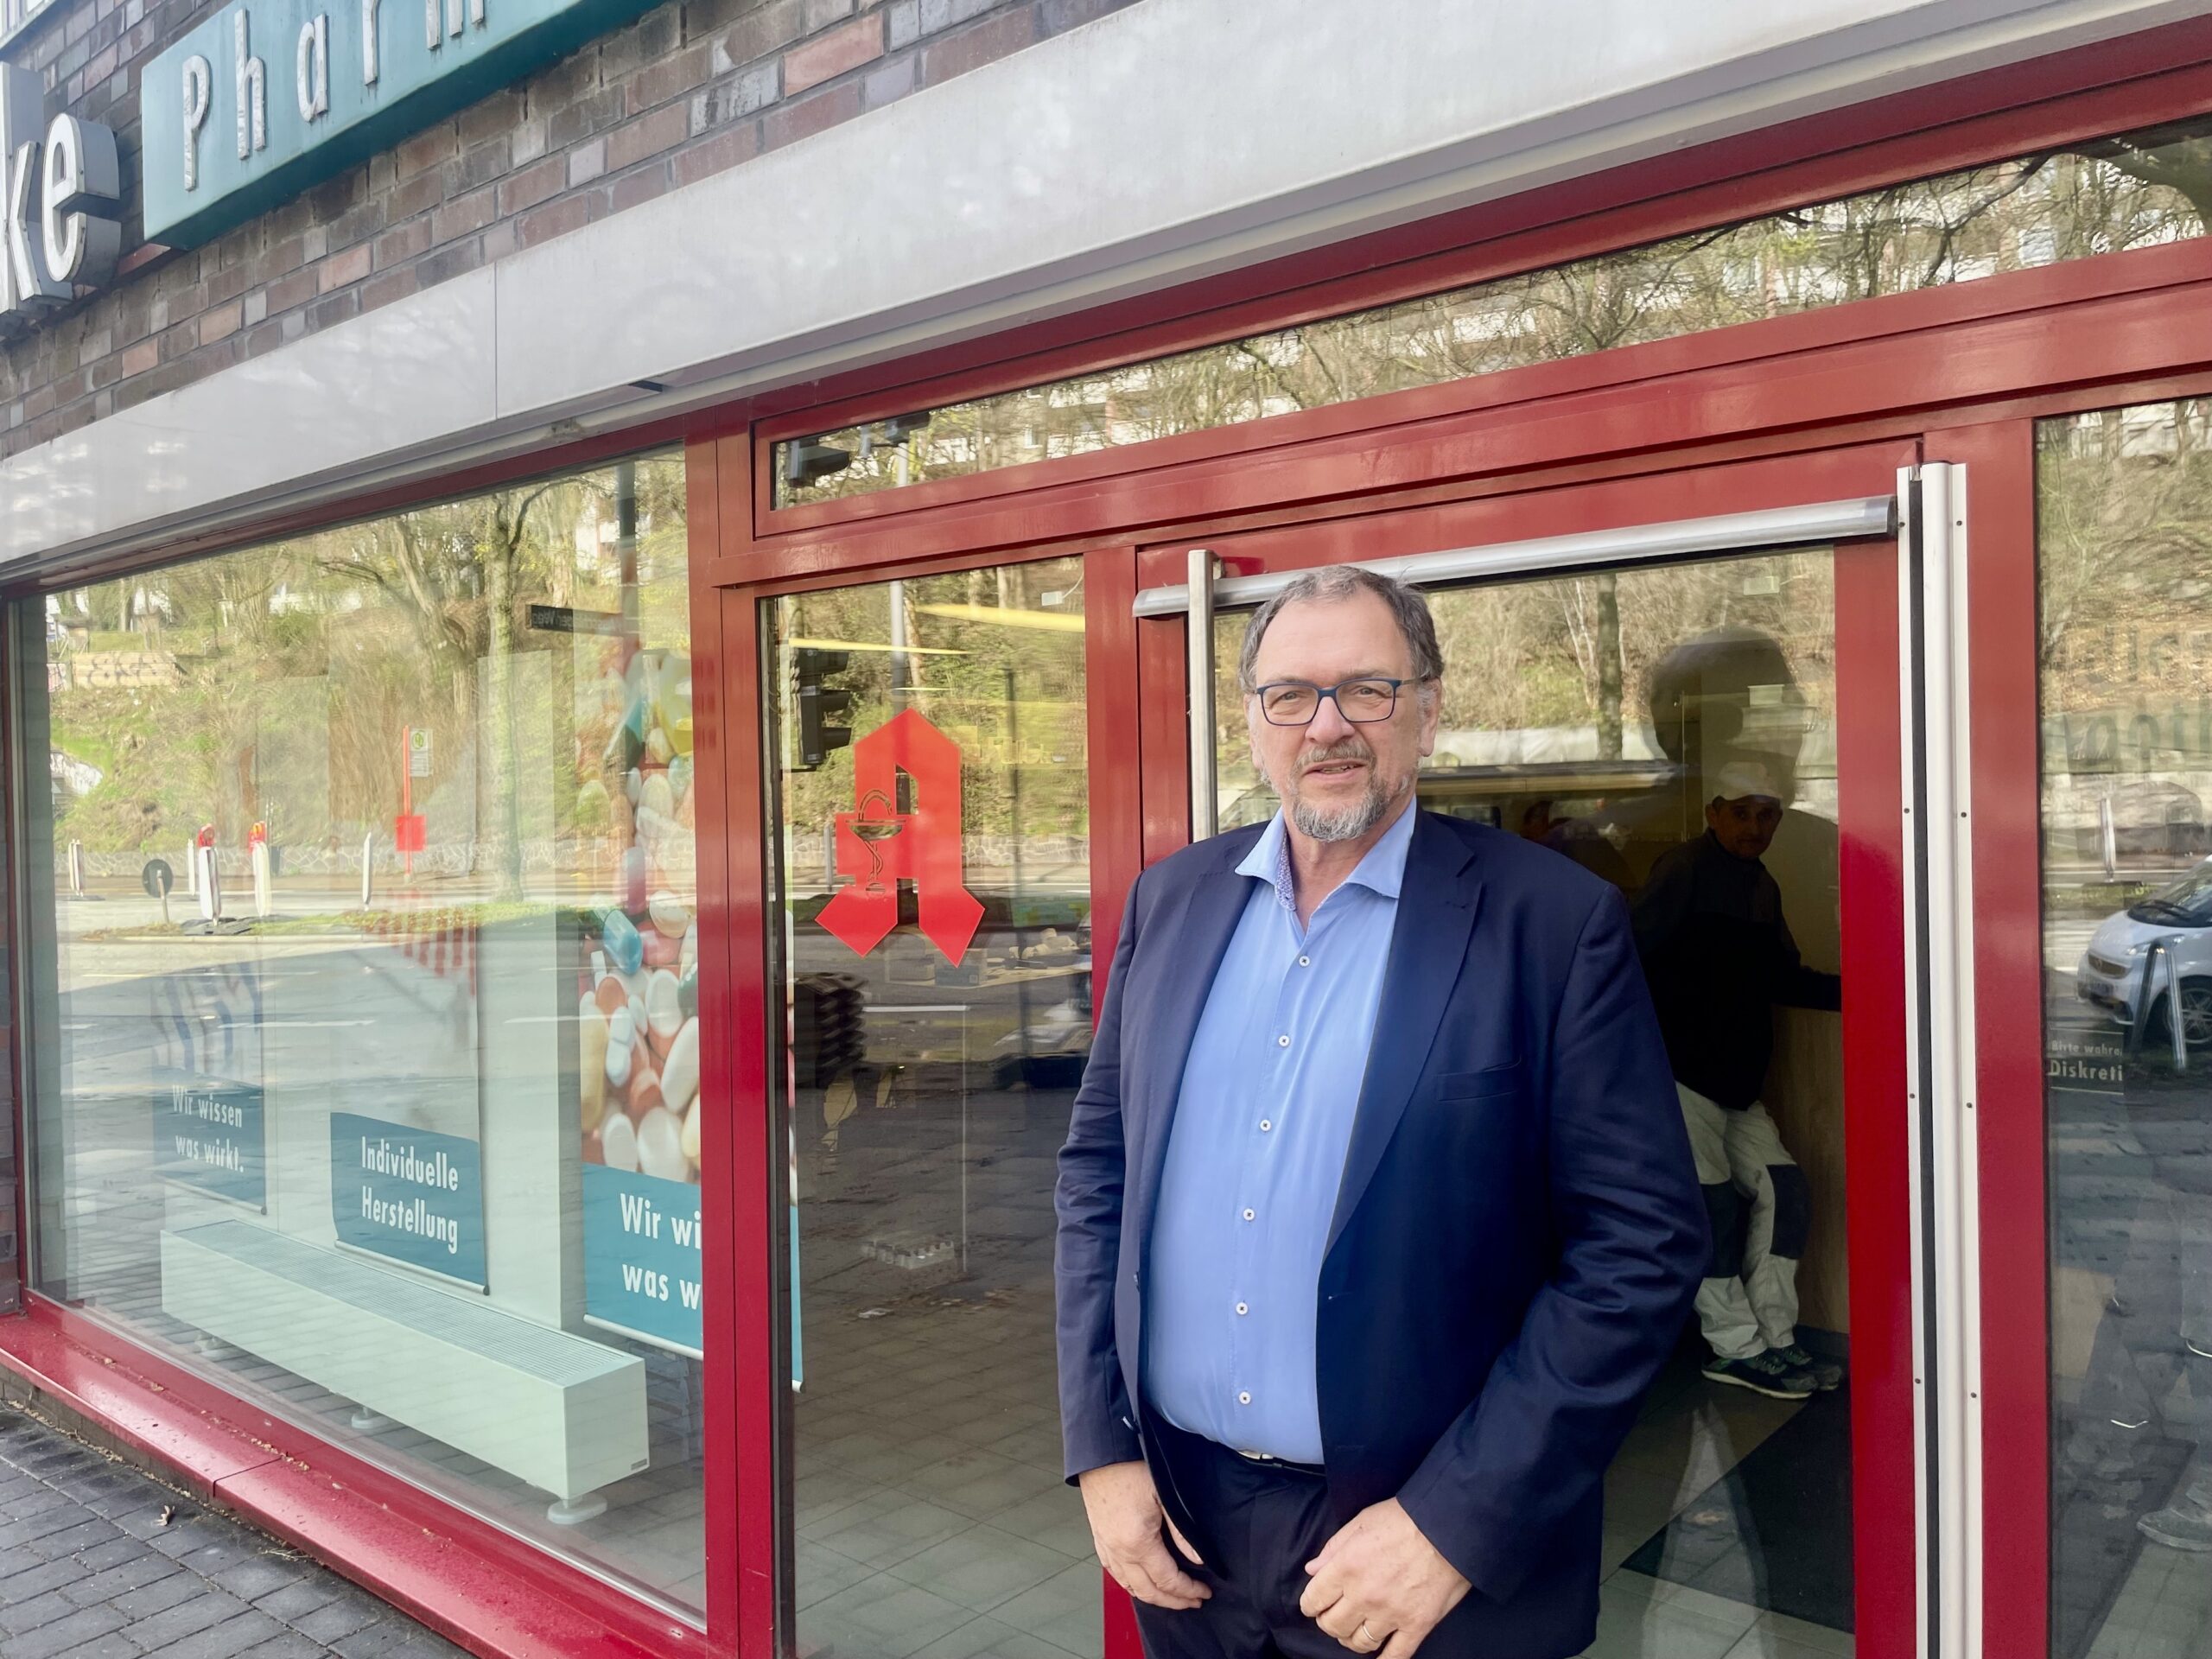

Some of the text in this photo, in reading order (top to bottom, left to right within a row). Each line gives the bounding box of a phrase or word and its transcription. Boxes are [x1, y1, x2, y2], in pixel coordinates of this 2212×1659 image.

[2050, 1059, 2123, 1081] Diskreti
[172, 1084, 243, 1128] Wir wissen
[175, 1135, 245, 1173] was wirkt.
[361, 1135, 459, 1192] Individuelle
[362, 1185, 459, 1255] Herstellung
[620, 1192, 662, 1239] Wir
[621, 1263, 669, 1302] was
